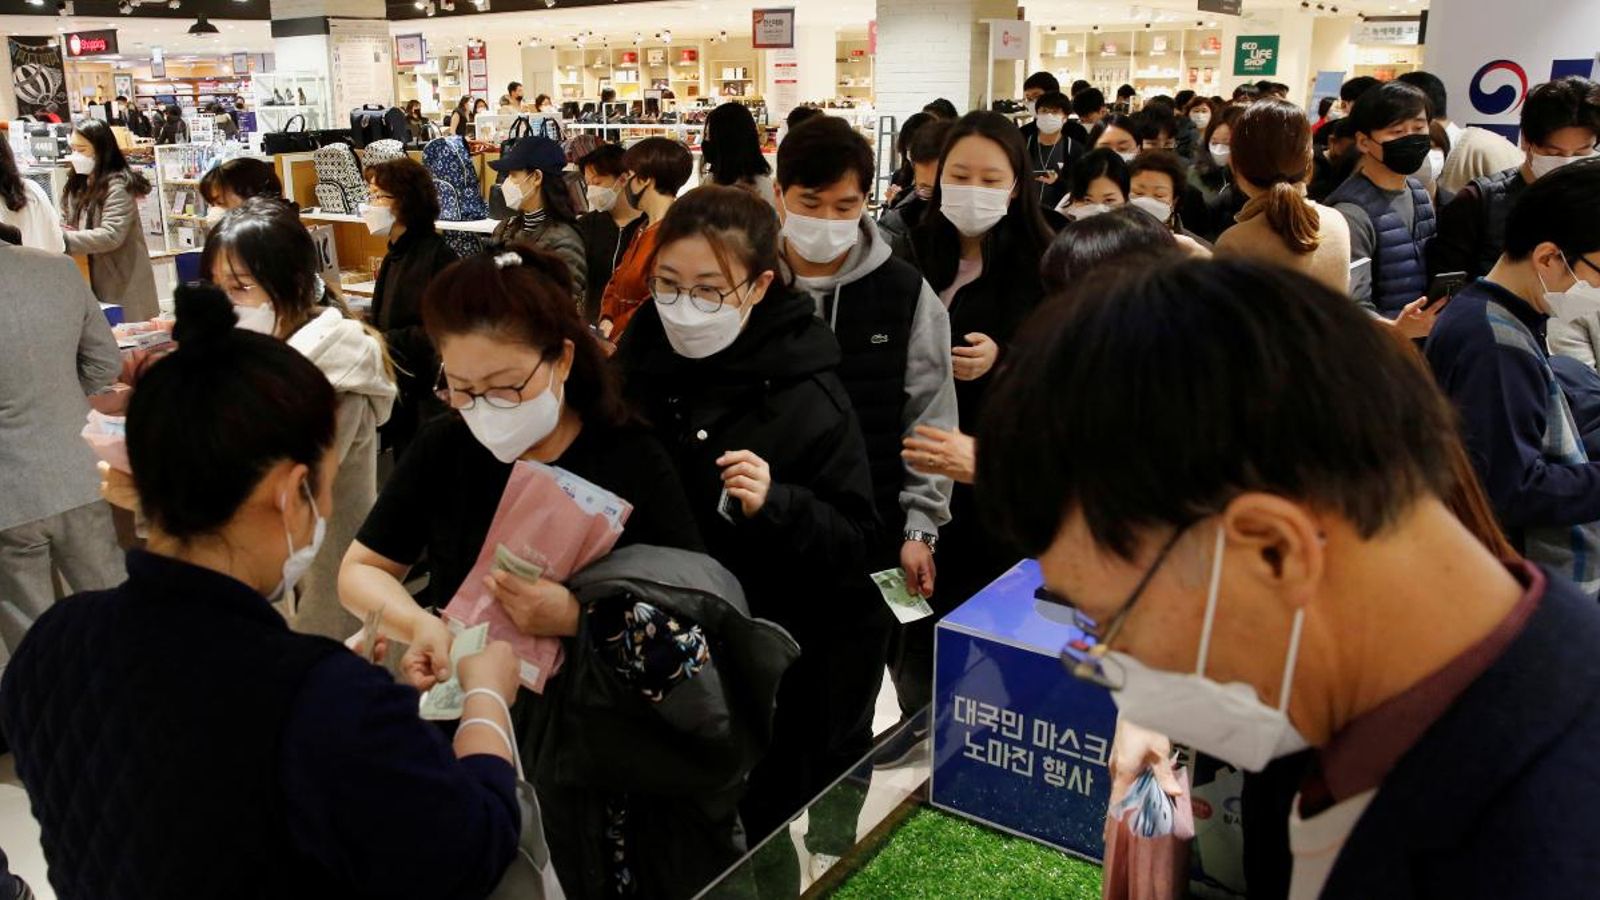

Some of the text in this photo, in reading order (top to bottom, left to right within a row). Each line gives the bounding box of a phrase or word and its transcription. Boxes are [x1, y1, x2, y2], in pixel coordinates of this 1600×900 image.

[1241, 42, 1258, 50] ECO
[1250, 49, 1273, 60] LIFE
[1244, 58, 1266, 66] SHOP
[954, 695, 1108, 767] 대국민 마스크
[963, 731, 1094, 796] 노마진 행사
